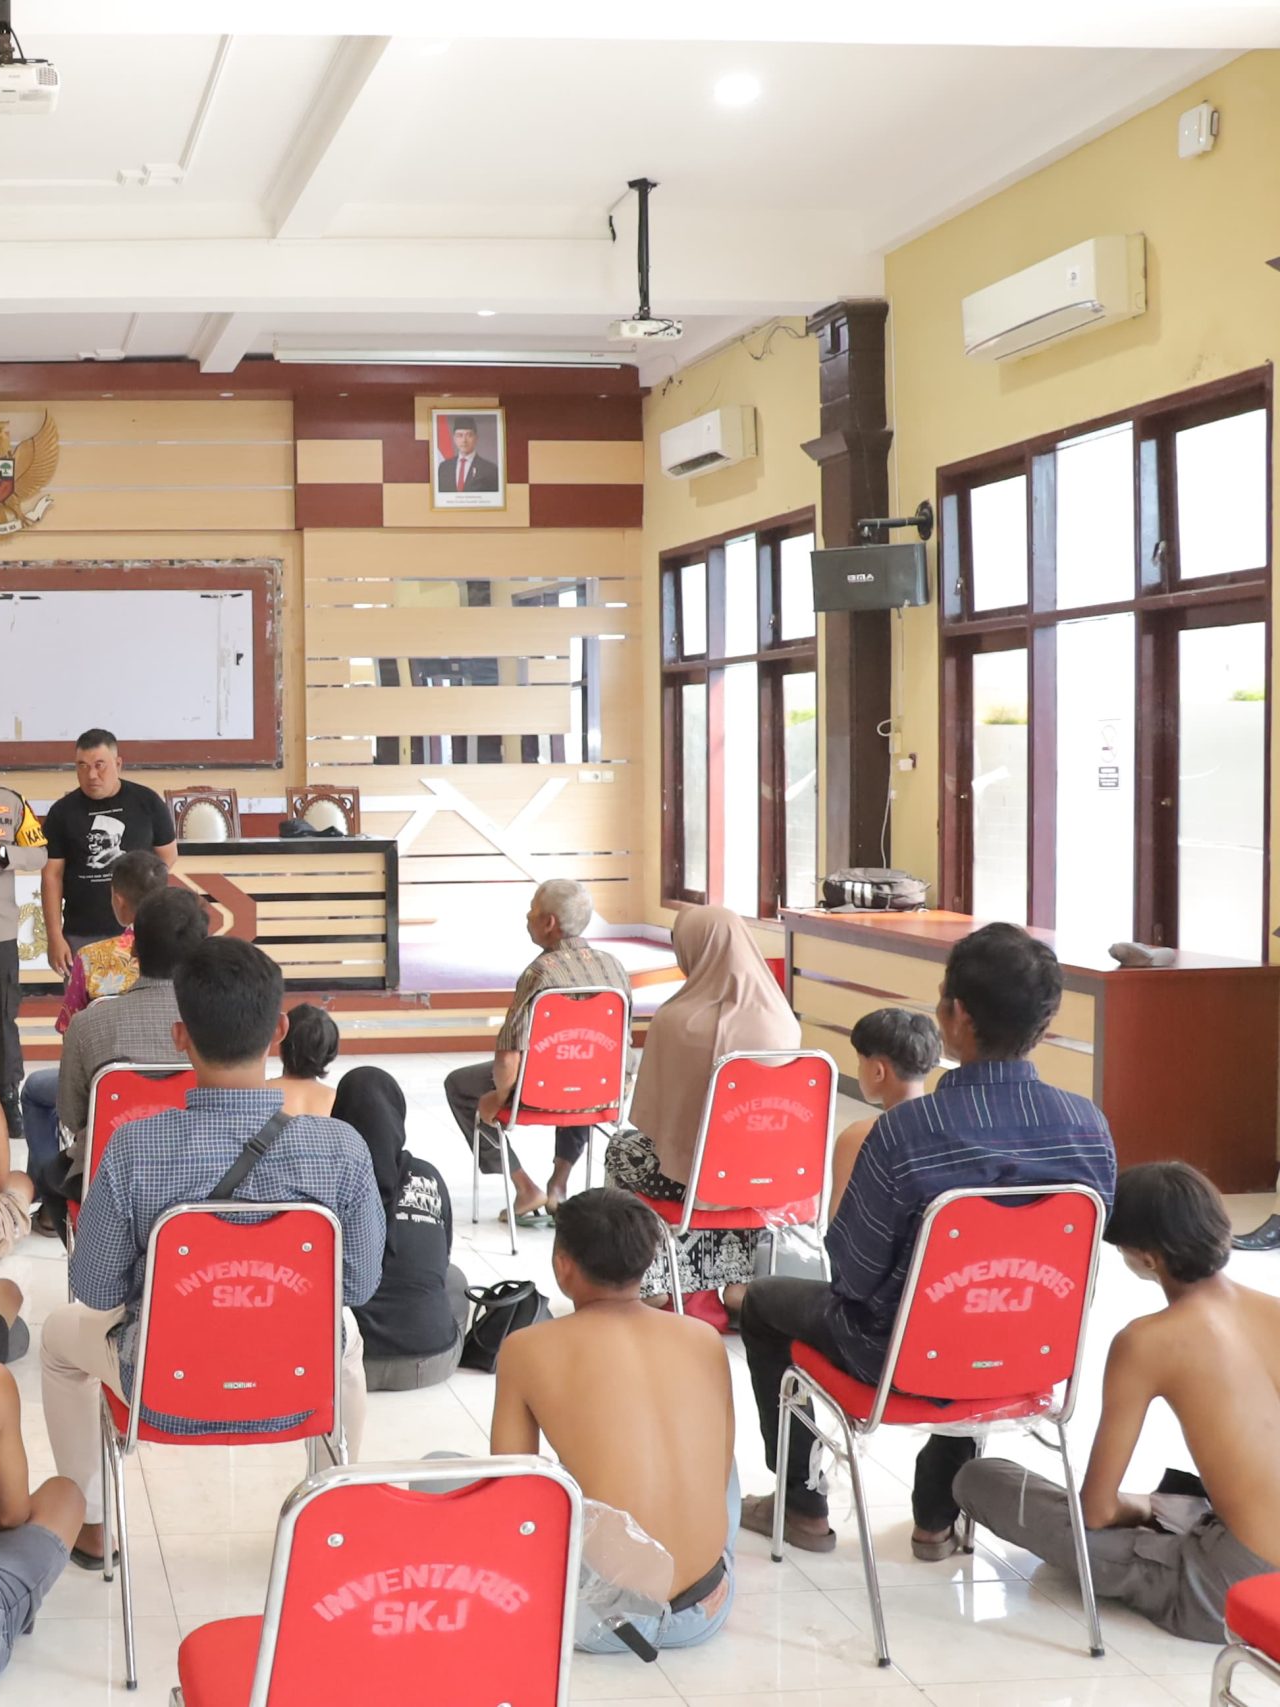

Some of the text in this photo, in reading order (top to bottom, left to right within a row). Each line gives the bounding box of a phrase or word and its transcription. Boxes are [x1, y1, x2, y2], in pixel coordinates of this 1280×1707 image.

[534, 1028, 617, 1054] INVENTARIS
[555, 1043, 595, 1060] SKJ
[722, 1097, 814, 1124] INVENTARIS
[746, 1114, 789, 1132] SKJ
[174, 1260, 314, 1297] INVENTARIS
[924, 1257, 1076, 1303] INVENTARIS
[212, 1284, 275, 1308] SKJ
[963, 1285, 1035, 1314] SKJ
[312, 1563, 530, 1622] INVENTARIS
[371, 1597, 469, 1636] SKJ
